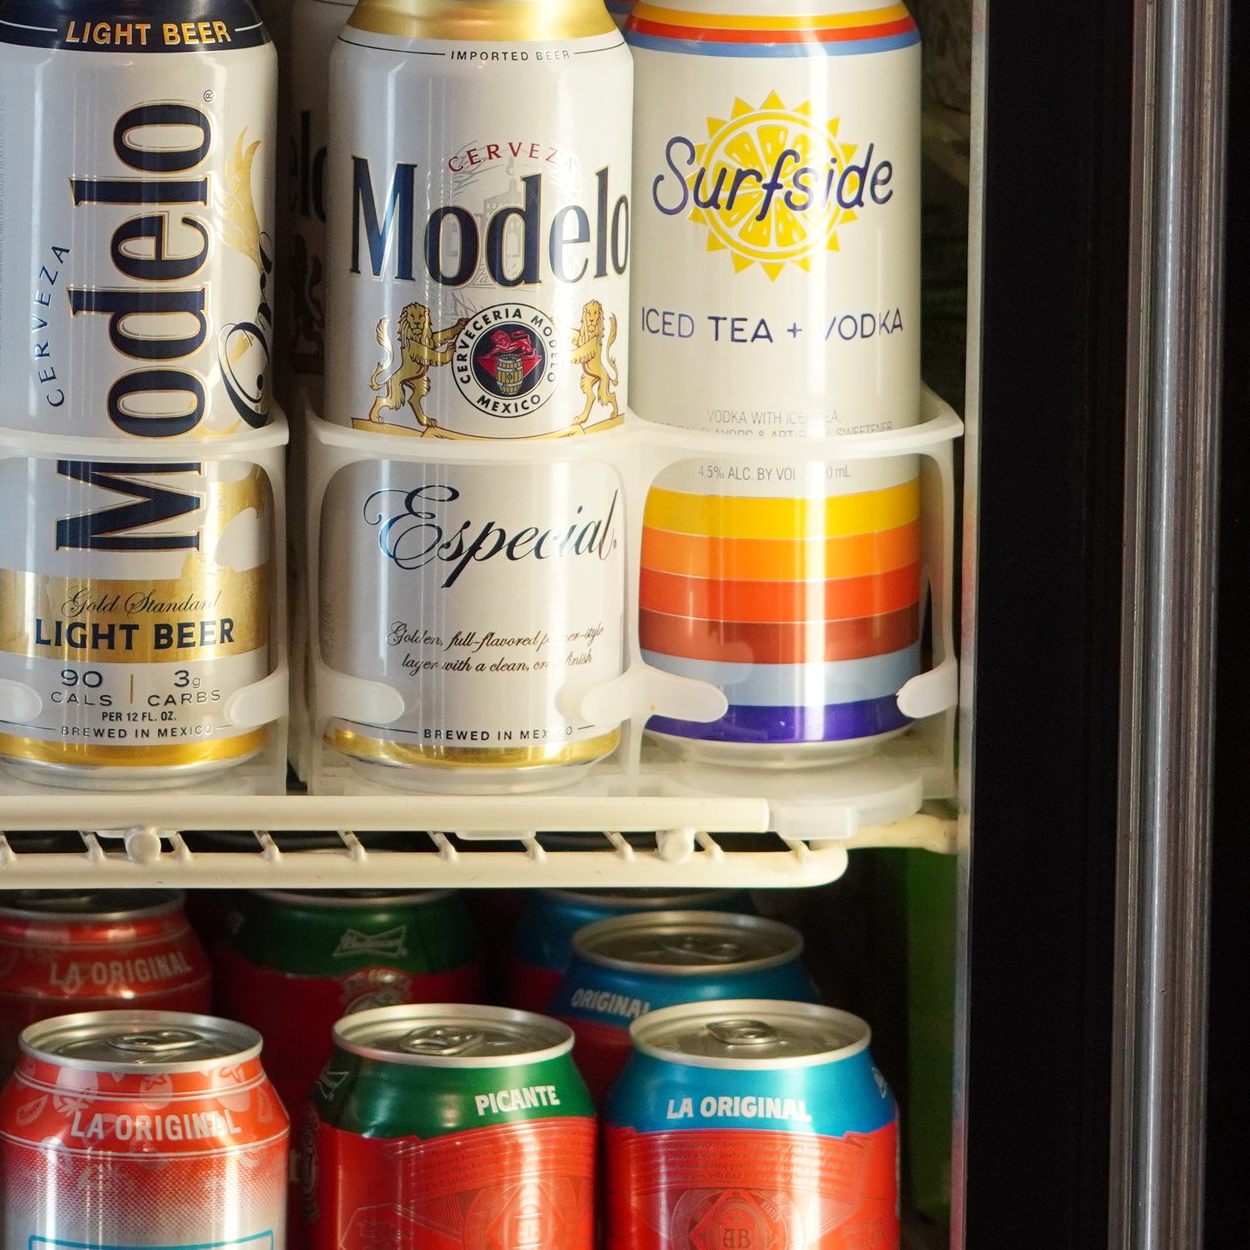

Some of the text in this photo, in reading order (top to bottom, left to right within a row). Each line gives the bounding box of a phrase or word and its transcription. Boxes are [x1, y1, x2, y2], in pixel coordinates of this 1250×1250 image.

[64, 20, 231, 45] LIGHT BEER
[450, 50, 529, 62] IMPORTED
[652, 136, 894, 222] Surfside
[349, 152, 630, 289] Modelo
[36, 244, 71, 409] CERVEZA
[55, 99, 214, 554] Modelo
[641, 306, 904, 343] ICED TEA VODKA
[459, 307, 523, 385] CERVECERIA
[475, 394, 542, 415] MEXICO
[707, 409, 782, 425] VODKA WITH
[757, 467, 773, 481] BY
[362, 484, 617, 590] Especial
[60, 585, 222, 619] Gold Standard
[34, 617, 236, 650] LIGHT BEER
[443, 629, 544, 654] full-flavored
[401, 653, 440, 676] lager
[441, 656, 473, 673] with
[489, 659, 531, 674] clean,
[60, 669, 103, 688] 90
[50, 691, 114, 707] CALS
[147, 689, 221, 707] CARBS
[101, 711, 138, 722] PER 12
[61, 725, 213, 739] BREWED IN MEXICO
[424, 729, 512, 741] BREWED IN
[91, 950, 193, 985] ORIGINAL
[474, 1085, 561, 1116] PICANTE
[666, 1096, 812, 1122] LA ORIGINAL
[70, 1108, 243, 1141] LA ORIGINAL
